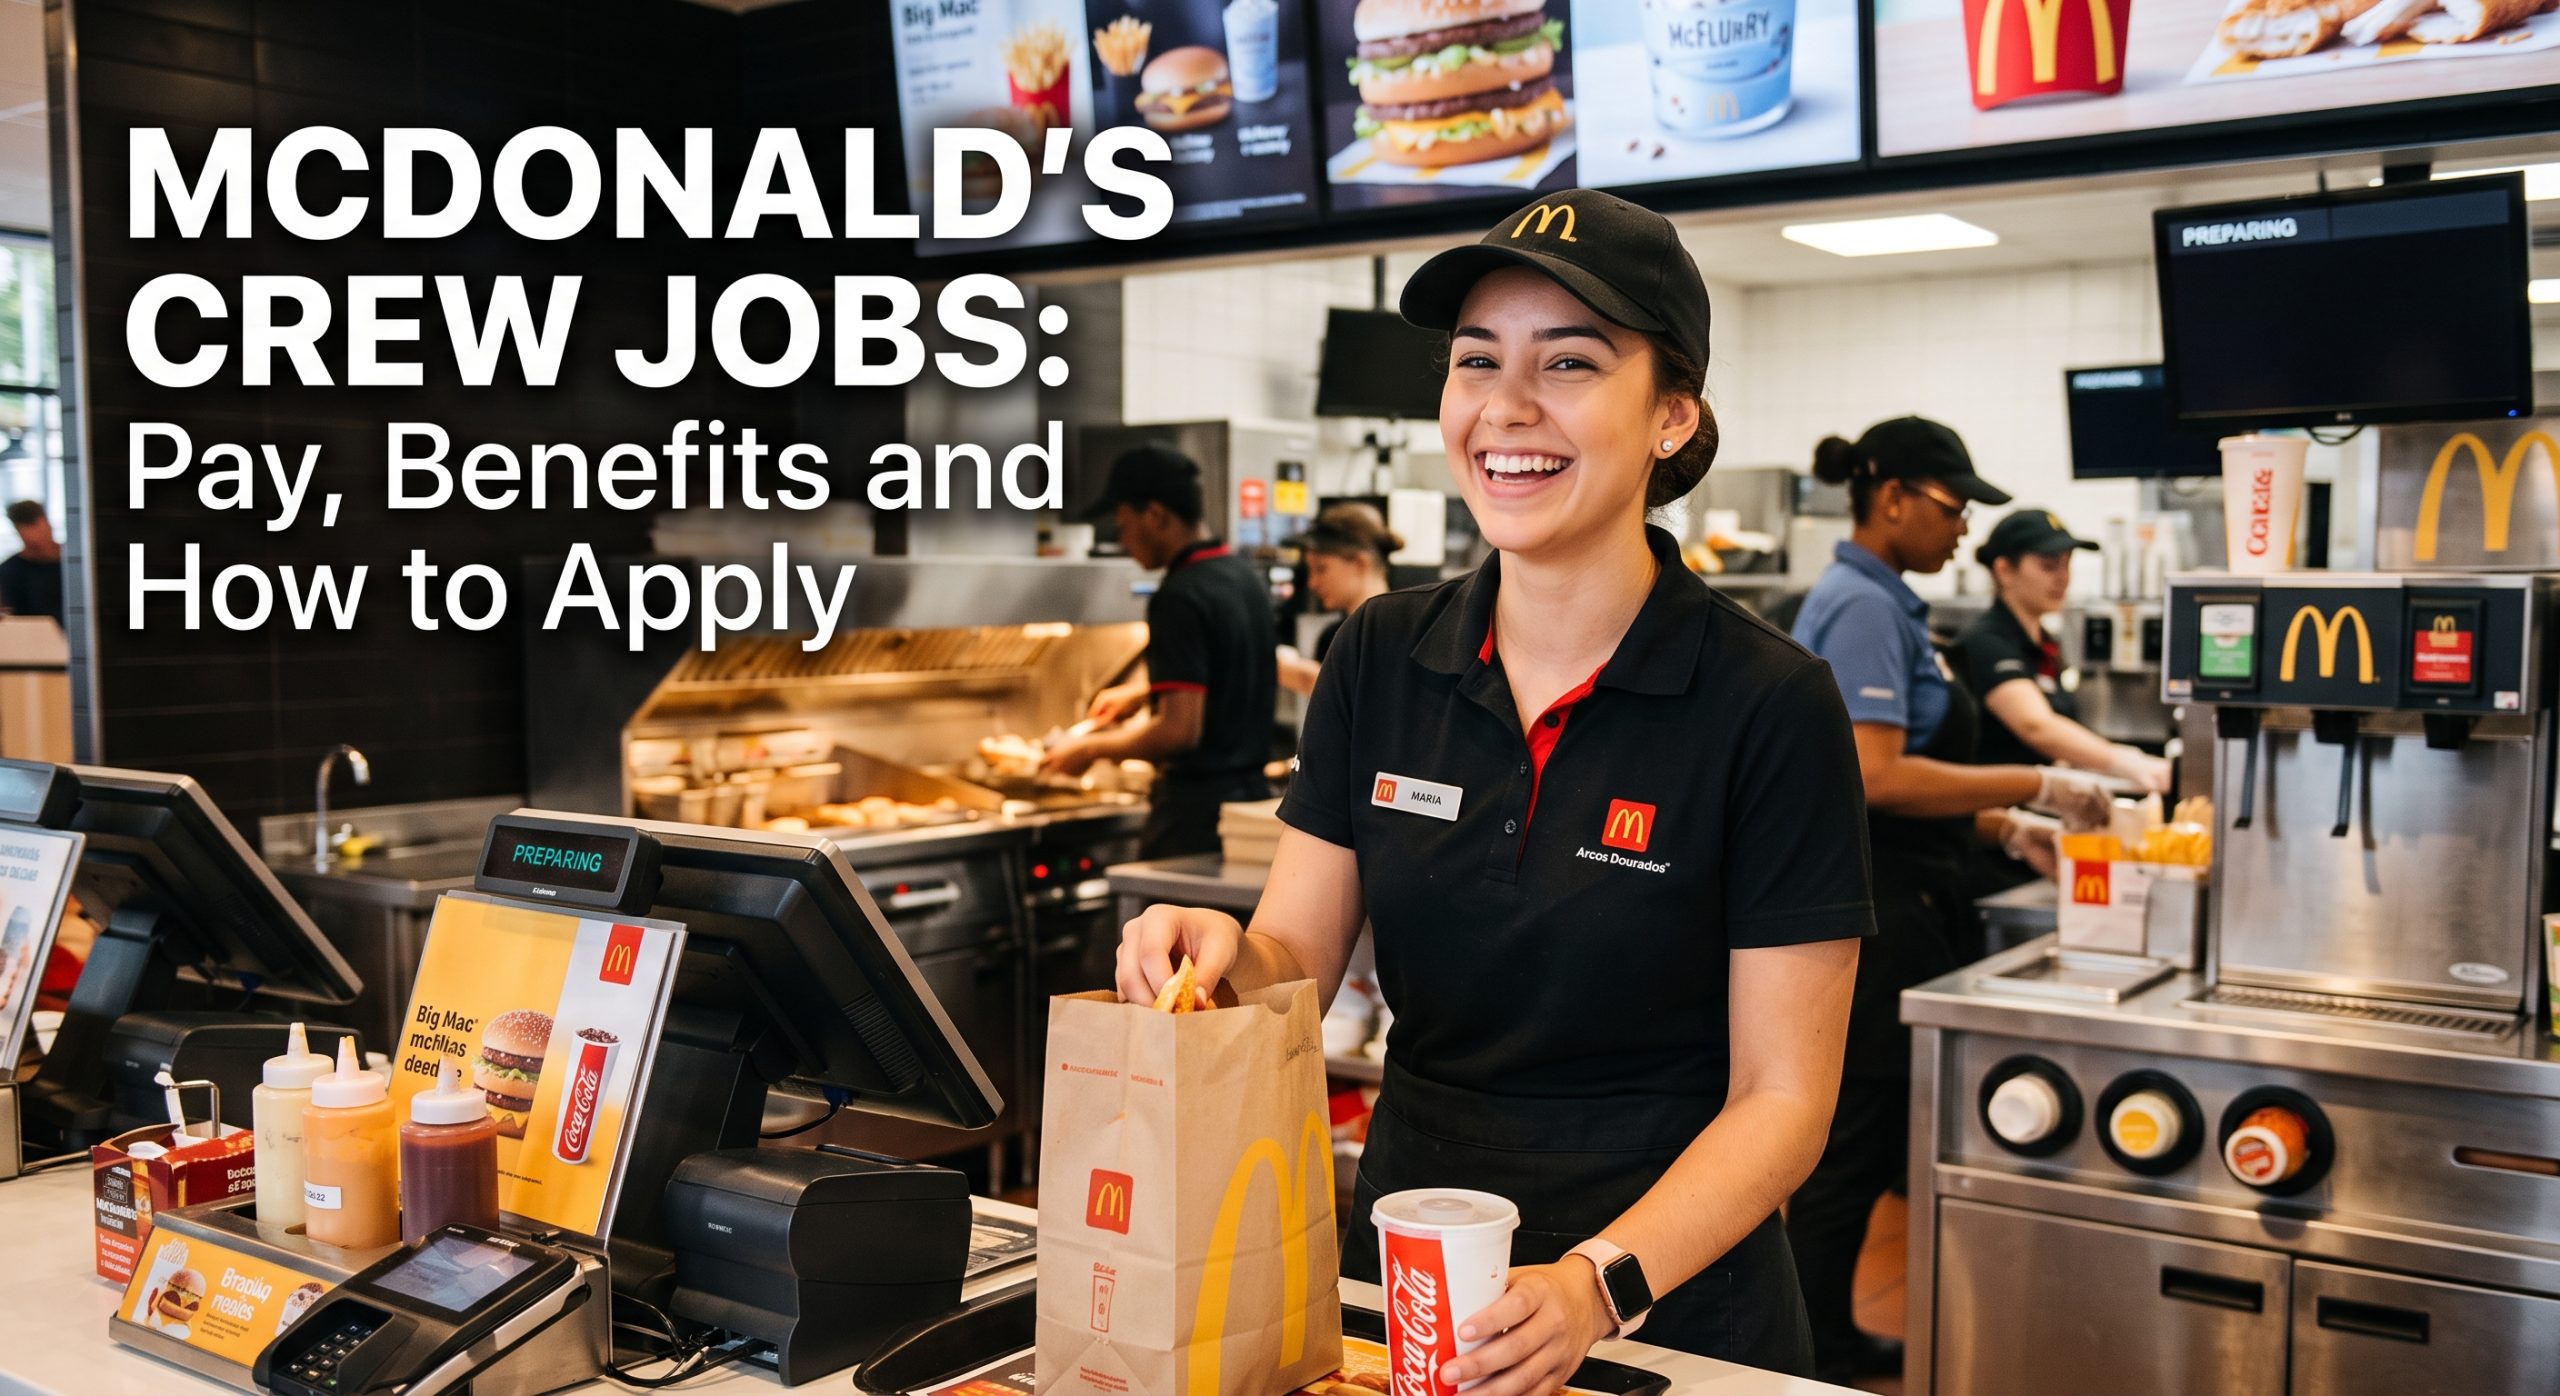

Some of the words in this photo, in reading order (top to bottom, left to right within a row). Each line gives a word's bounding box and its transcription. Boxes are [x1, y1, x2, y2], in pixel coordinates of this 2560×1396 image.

[2182, 218, 2297, 247] PREPARING
[1411, 791, 1442, 806] MARIA
[512, 844, 602, 873] PREPARING
[1576, 846, 1608, 863] Arcos
[416, 1005, 440, 1031] Big
